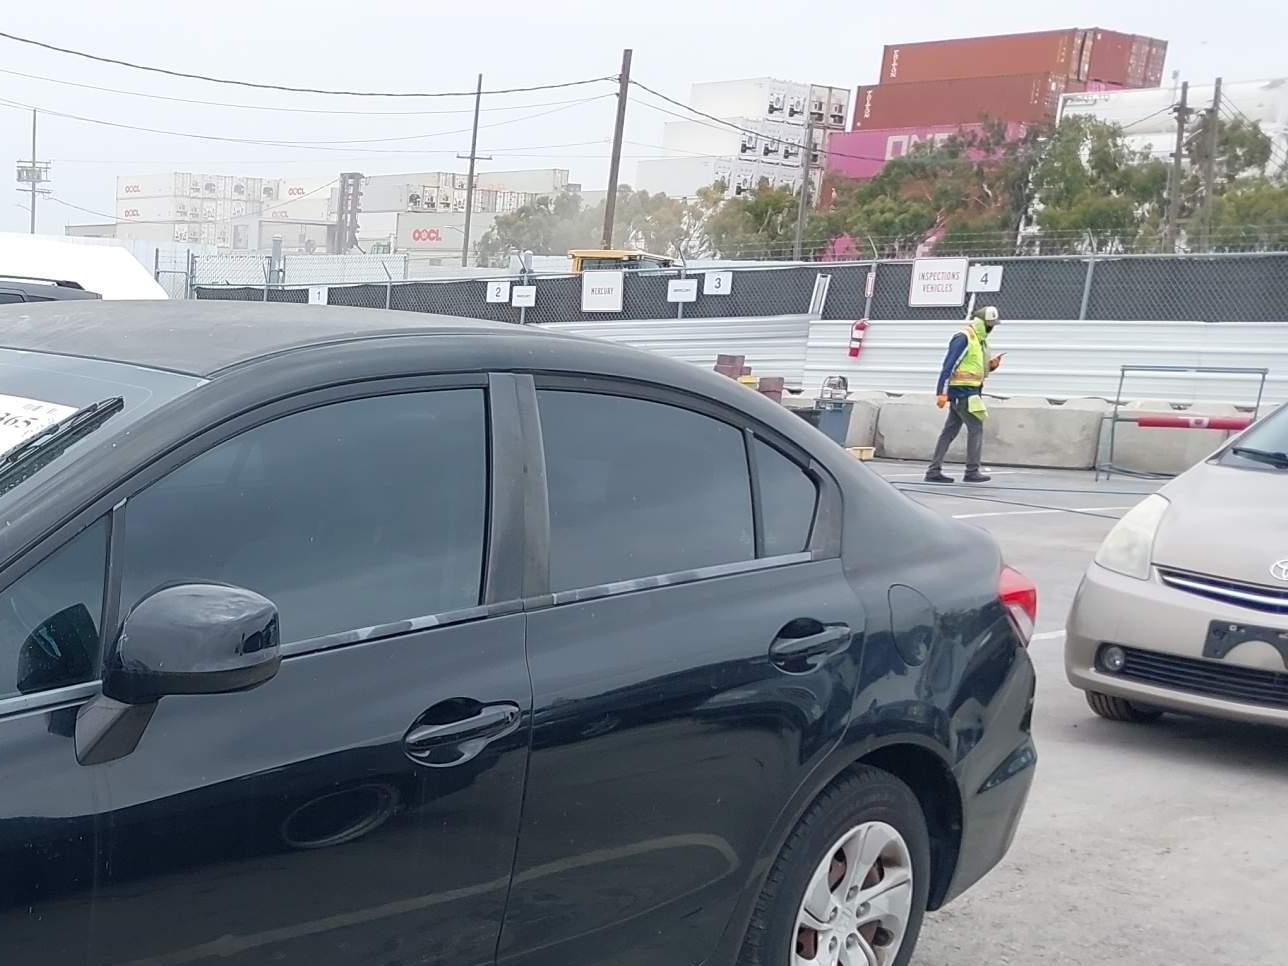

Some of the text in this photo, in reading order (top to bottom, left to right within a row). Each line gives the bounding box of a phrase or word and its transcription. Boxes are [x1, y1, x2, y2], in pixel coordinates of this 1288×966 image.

[412, 229, 442, 241] OOCL
[918, 271, 960, 281] INSPECTIONS
[980, 272, 989, 285] 4
[714, 277, 722, 289] 3
[921, 283, 953, 293] VEHICLES
[495, 287, 501, 297] 2
[590, 287, 614, 296] MERCURY
